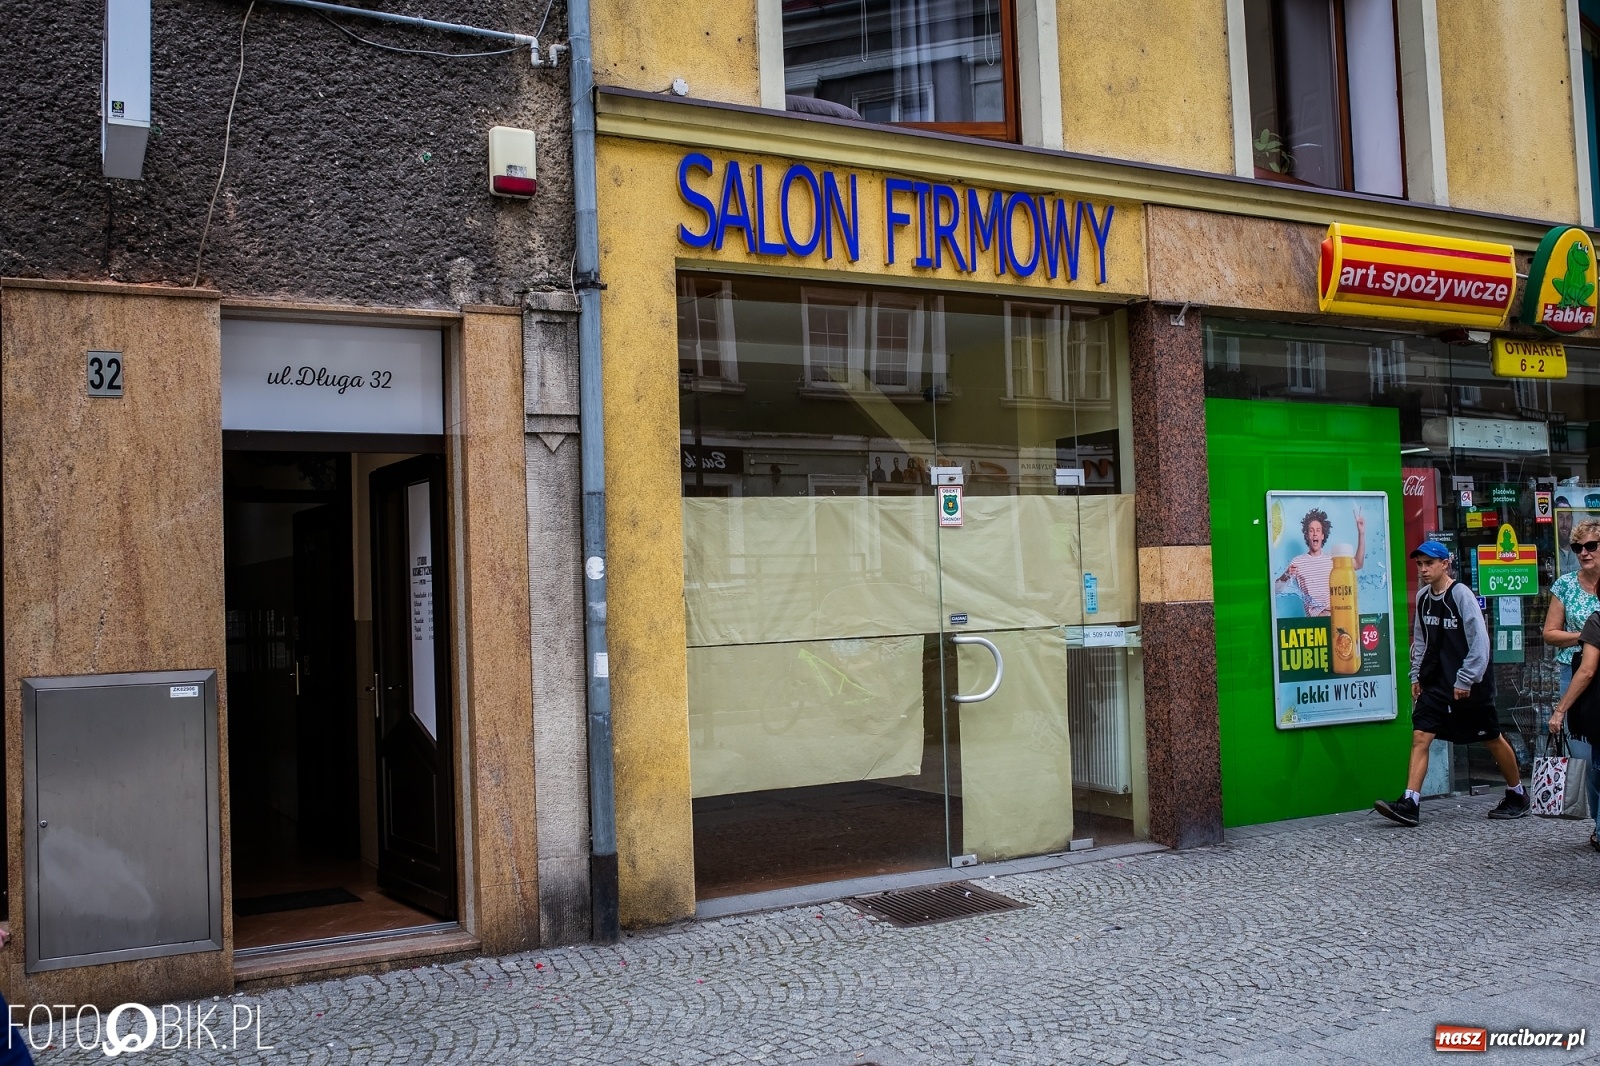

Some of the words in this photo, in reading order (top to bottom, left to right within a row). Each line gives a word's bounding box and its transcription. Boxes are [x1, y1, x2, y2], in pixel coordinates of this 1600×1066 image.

[676, 151, 860, 263] SALON
[883, 177, 1116, 285] FIRMOWY
[1339, 263, 1509, 303] art.spożywcze
[1542, 305, 1596, 326] żabka
[1504, 341, 1564, 358] OTWARTE
[89, 355, 122, 392] 32
[267, 364, 365, 396] ul.Długa
[369, 368, 394, 390] 32
[1498, 551, 1517, 559] żabka
[1280, 627, 1328, 649] LATEM
[1281, 647, 1329, 673] LUBIĘ
[1296, 684, 1330, 705] lekki
[1334, 681, 1377, 701] WYCISK
